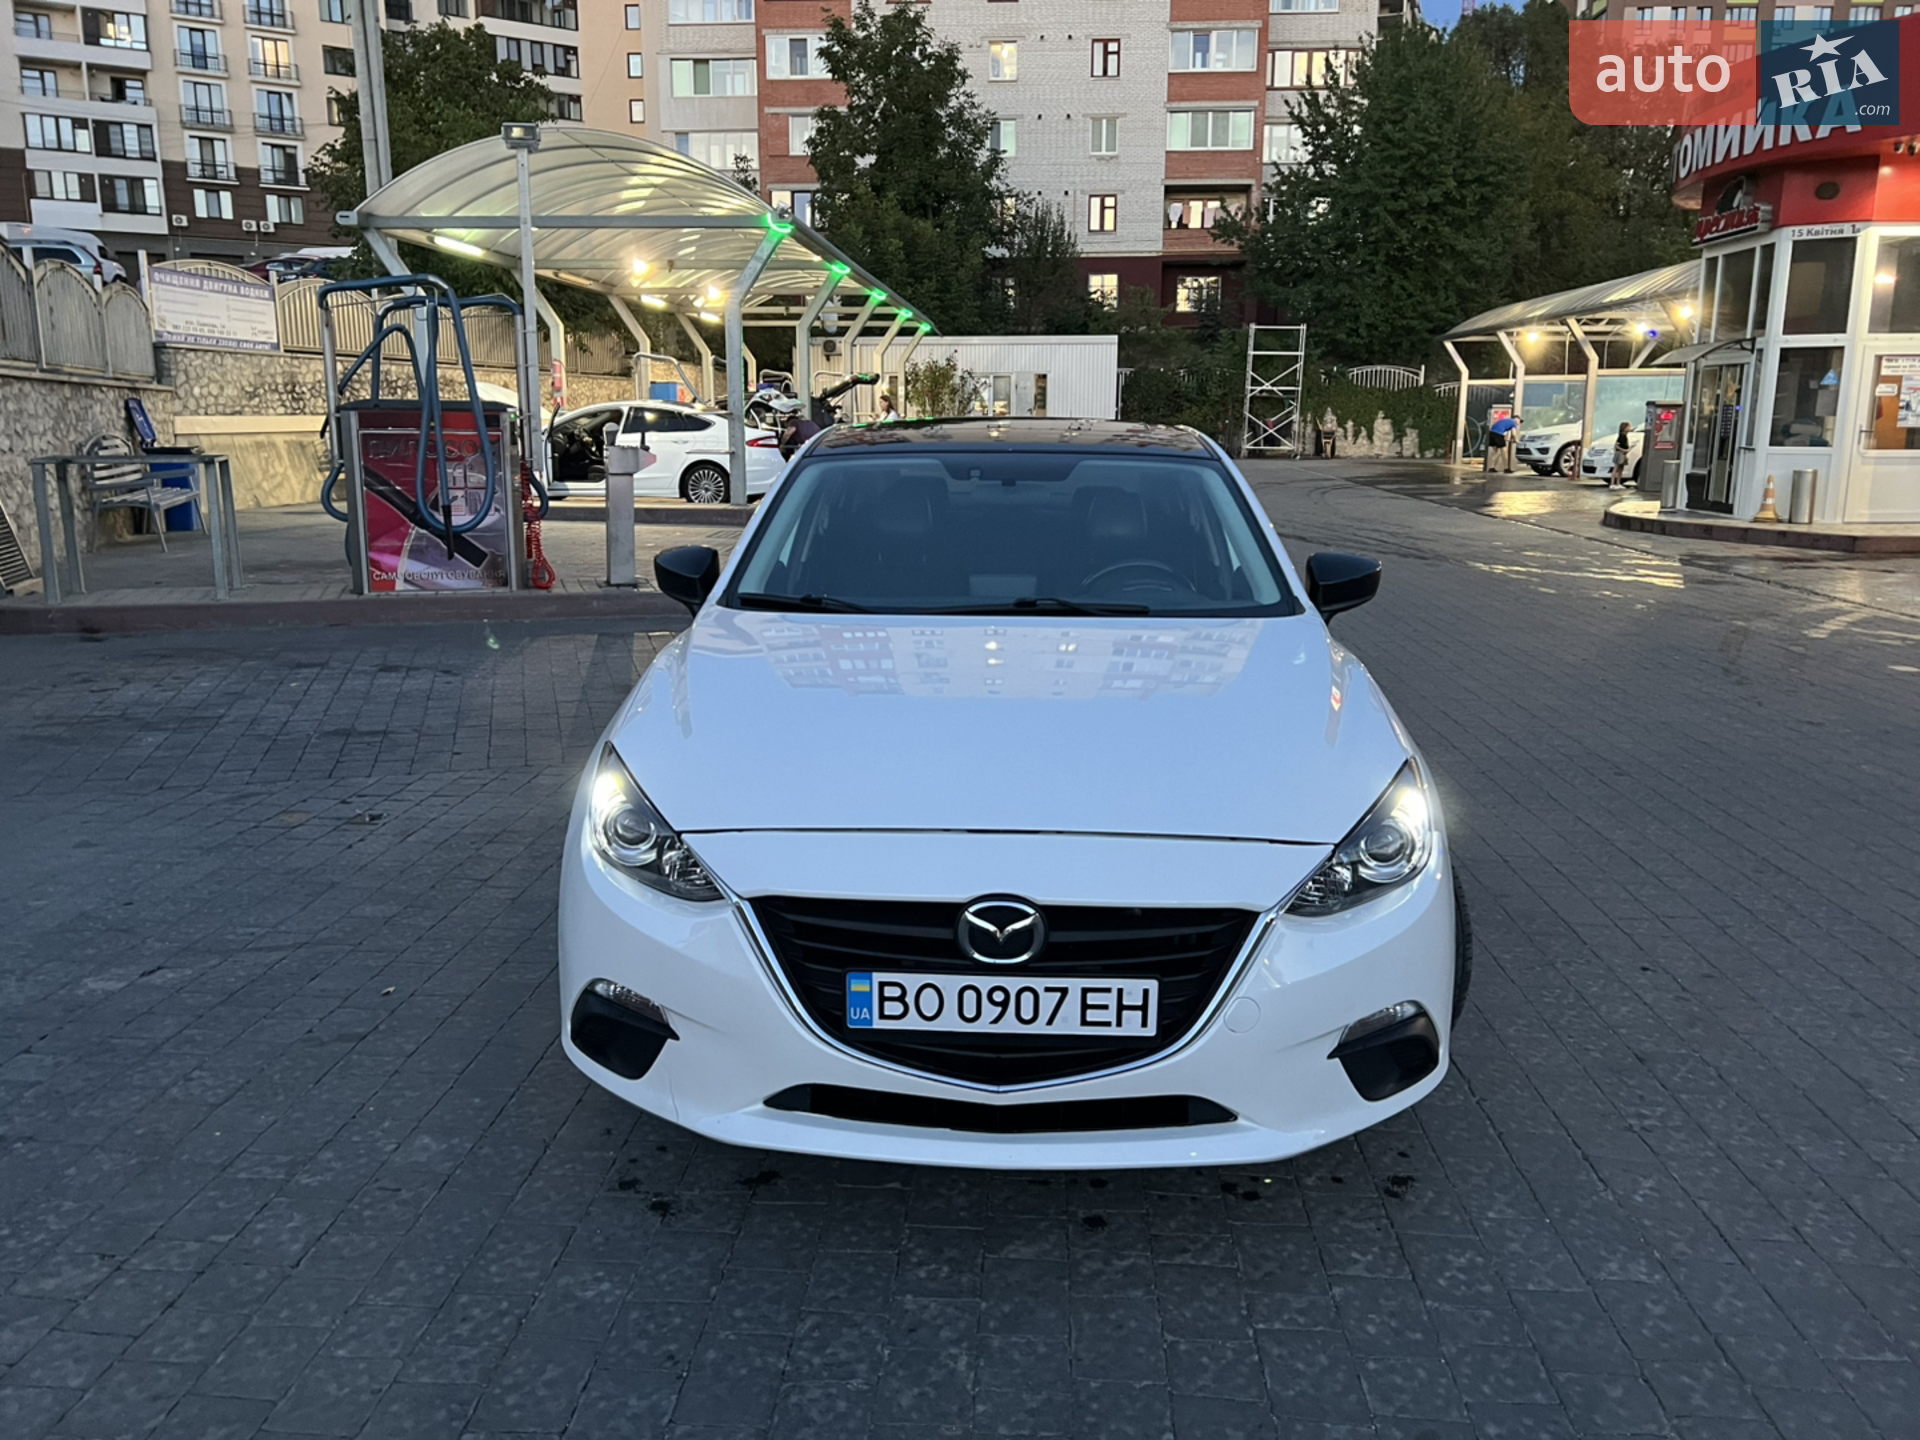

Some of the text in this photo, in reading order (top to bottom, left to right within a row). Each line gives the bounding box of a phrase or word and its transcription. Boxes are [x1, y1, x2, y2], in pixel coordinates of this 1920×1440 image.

[1791, 228, 1804, 238] 15
[1806, 226, 1845, 237] Квітня
[154, 271, 200, 287] ОЧИЩЕННЯ
[202, 280, 238, 293] ДВИГУНА
[850, 1006, 871, 1020] UA
[877, 980, 1150, 1029] BO 0907 EH
